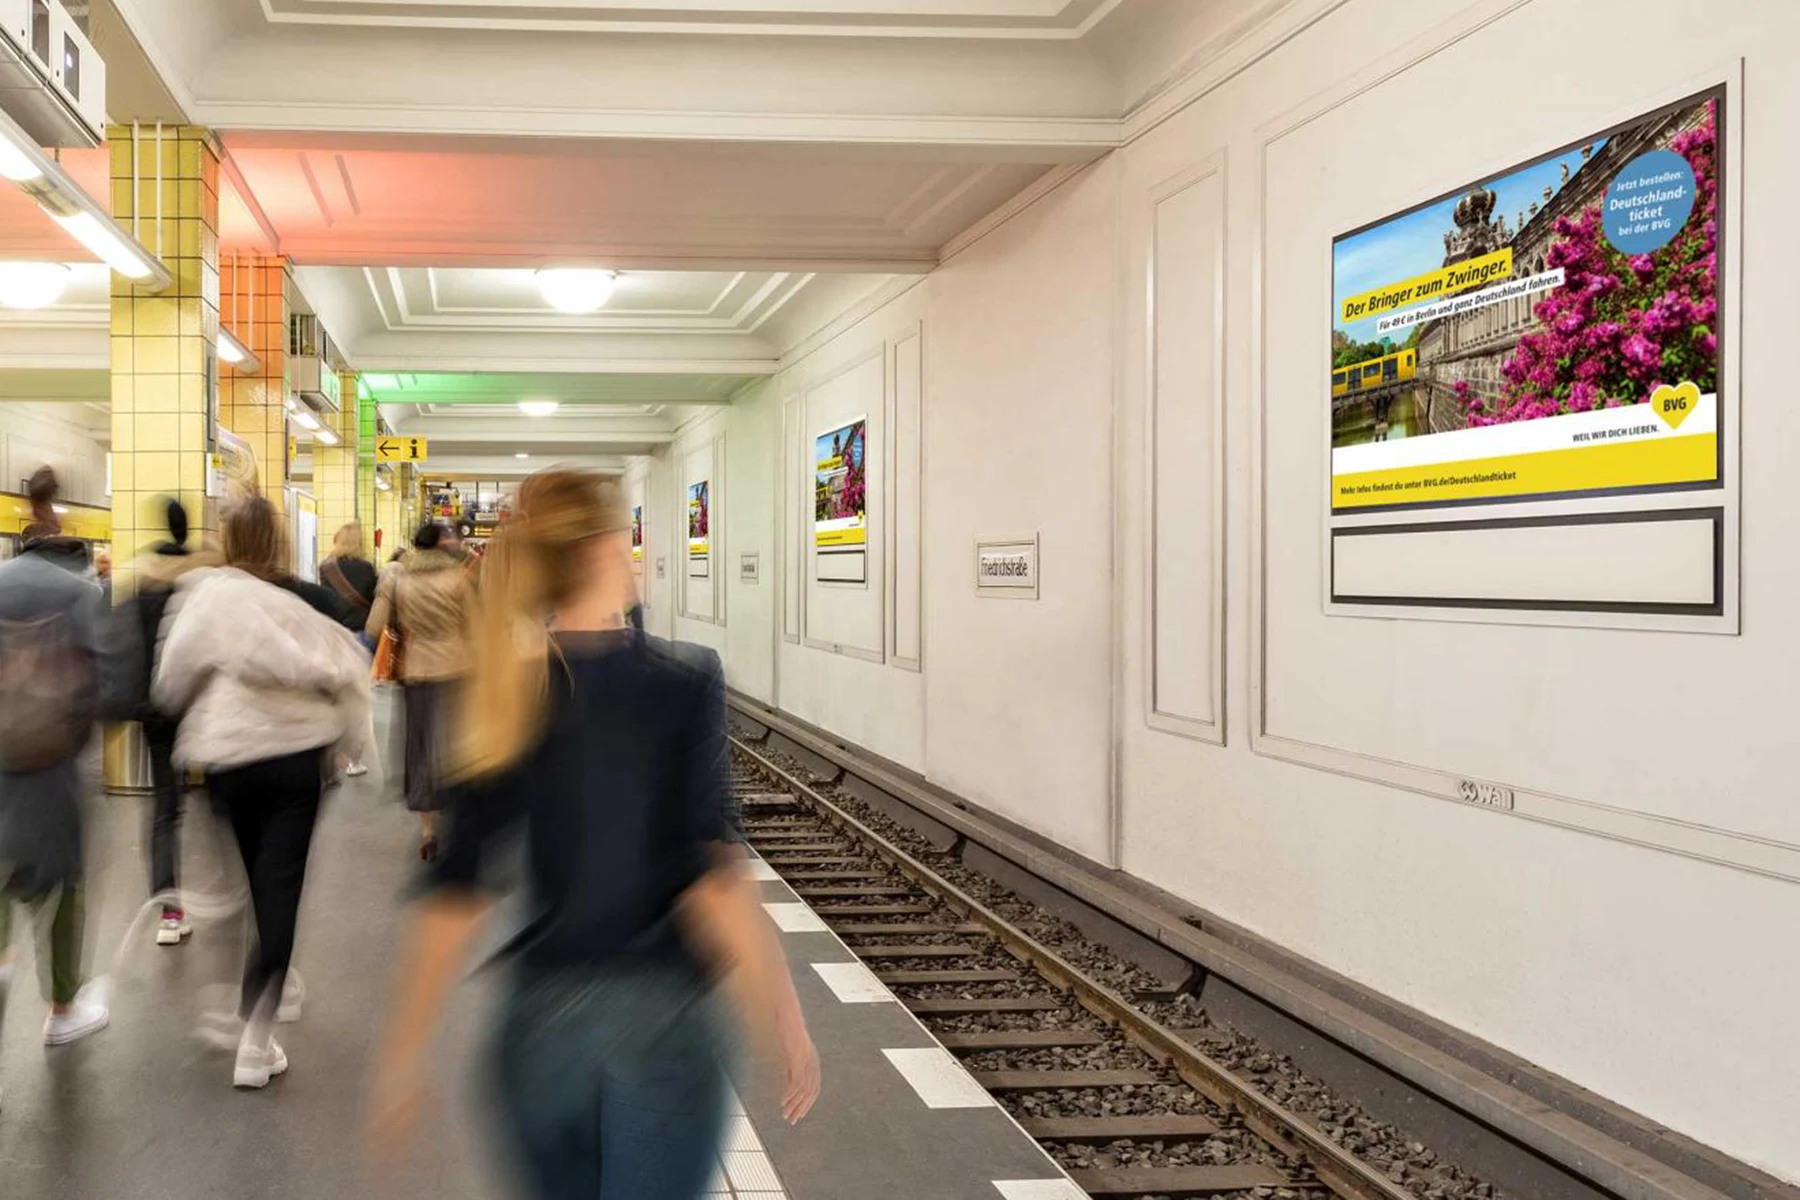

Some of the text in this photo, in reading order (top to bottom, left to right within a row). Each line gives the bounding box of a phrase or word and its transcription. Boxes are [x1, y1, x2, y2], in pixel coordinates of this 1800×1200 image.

[1616, 180, 1637, 191] Jetzt
[1610, 185, 1687, 211] Deutschland-
[1629, 206, 1663, 221] ticket
[1618, 218, 1671, 236] bei der BVG
[1345, 259, 1507, 318] Der Bringer zum Zwinger.
[1379, 321, 1391, 330] Für
[1415, 307, 1437, 320] Berlin
[1438, 302, 1453, 314] und
[1454, 299, 1473, 312] ganz
[1475, 282, 1527, 305] Deutschland
[1529, 274, 1560, 289] fahren.
[1663, 397, 1687, 412] BVG
[1572, 424, 1659, 442] WEIL WIR DICH LIEBEN.
